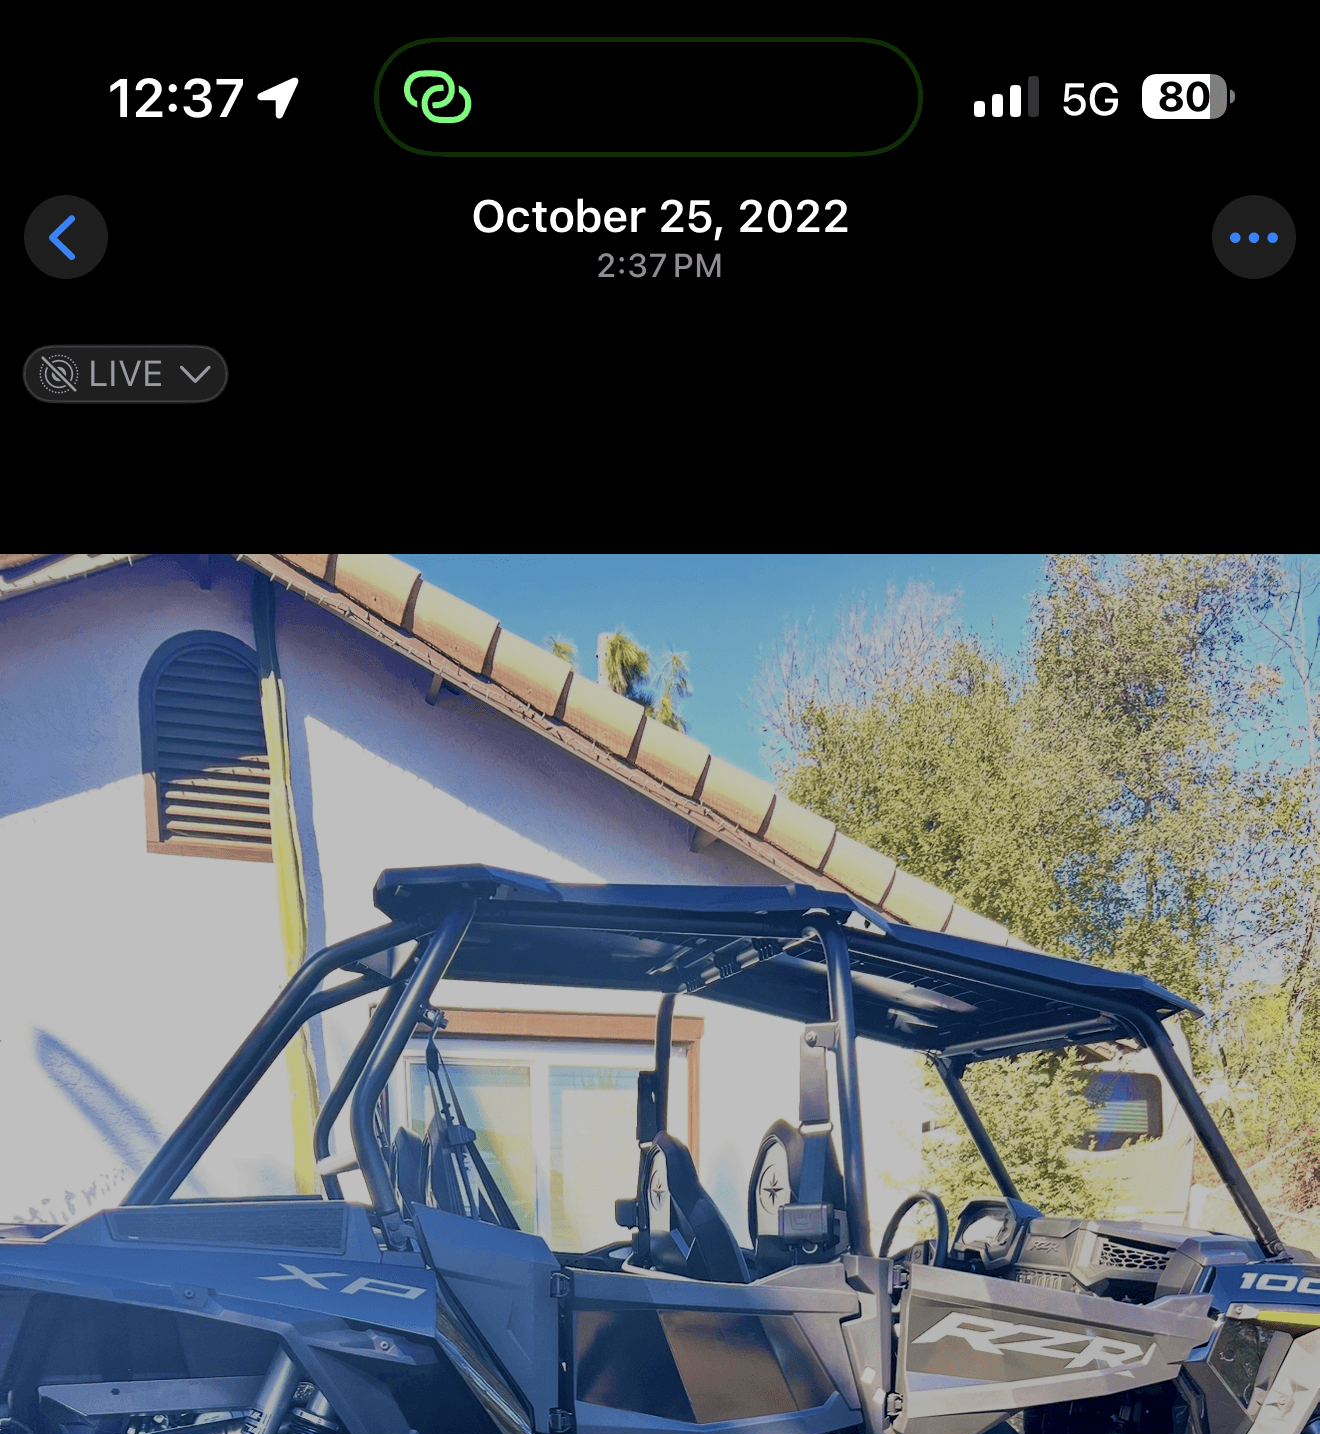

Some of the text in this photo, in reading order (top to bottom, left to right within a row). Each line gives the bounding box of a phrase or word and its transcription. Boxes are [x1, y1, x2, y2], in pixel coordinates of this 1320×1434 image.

[109, 77, 244, 119] 12:37
[1062, 81, 1119, 117] 5G
[1158, 80, 1210, 113] 80
[472, 198, 848, 241] October 25, 2022
[597, 252, 721, 278] 2:37 PM
[90, 360, 162, 387] LIVE
[257, 1263, 427, 1299] XP
[911, 1311, 1157, 1378] RZR
